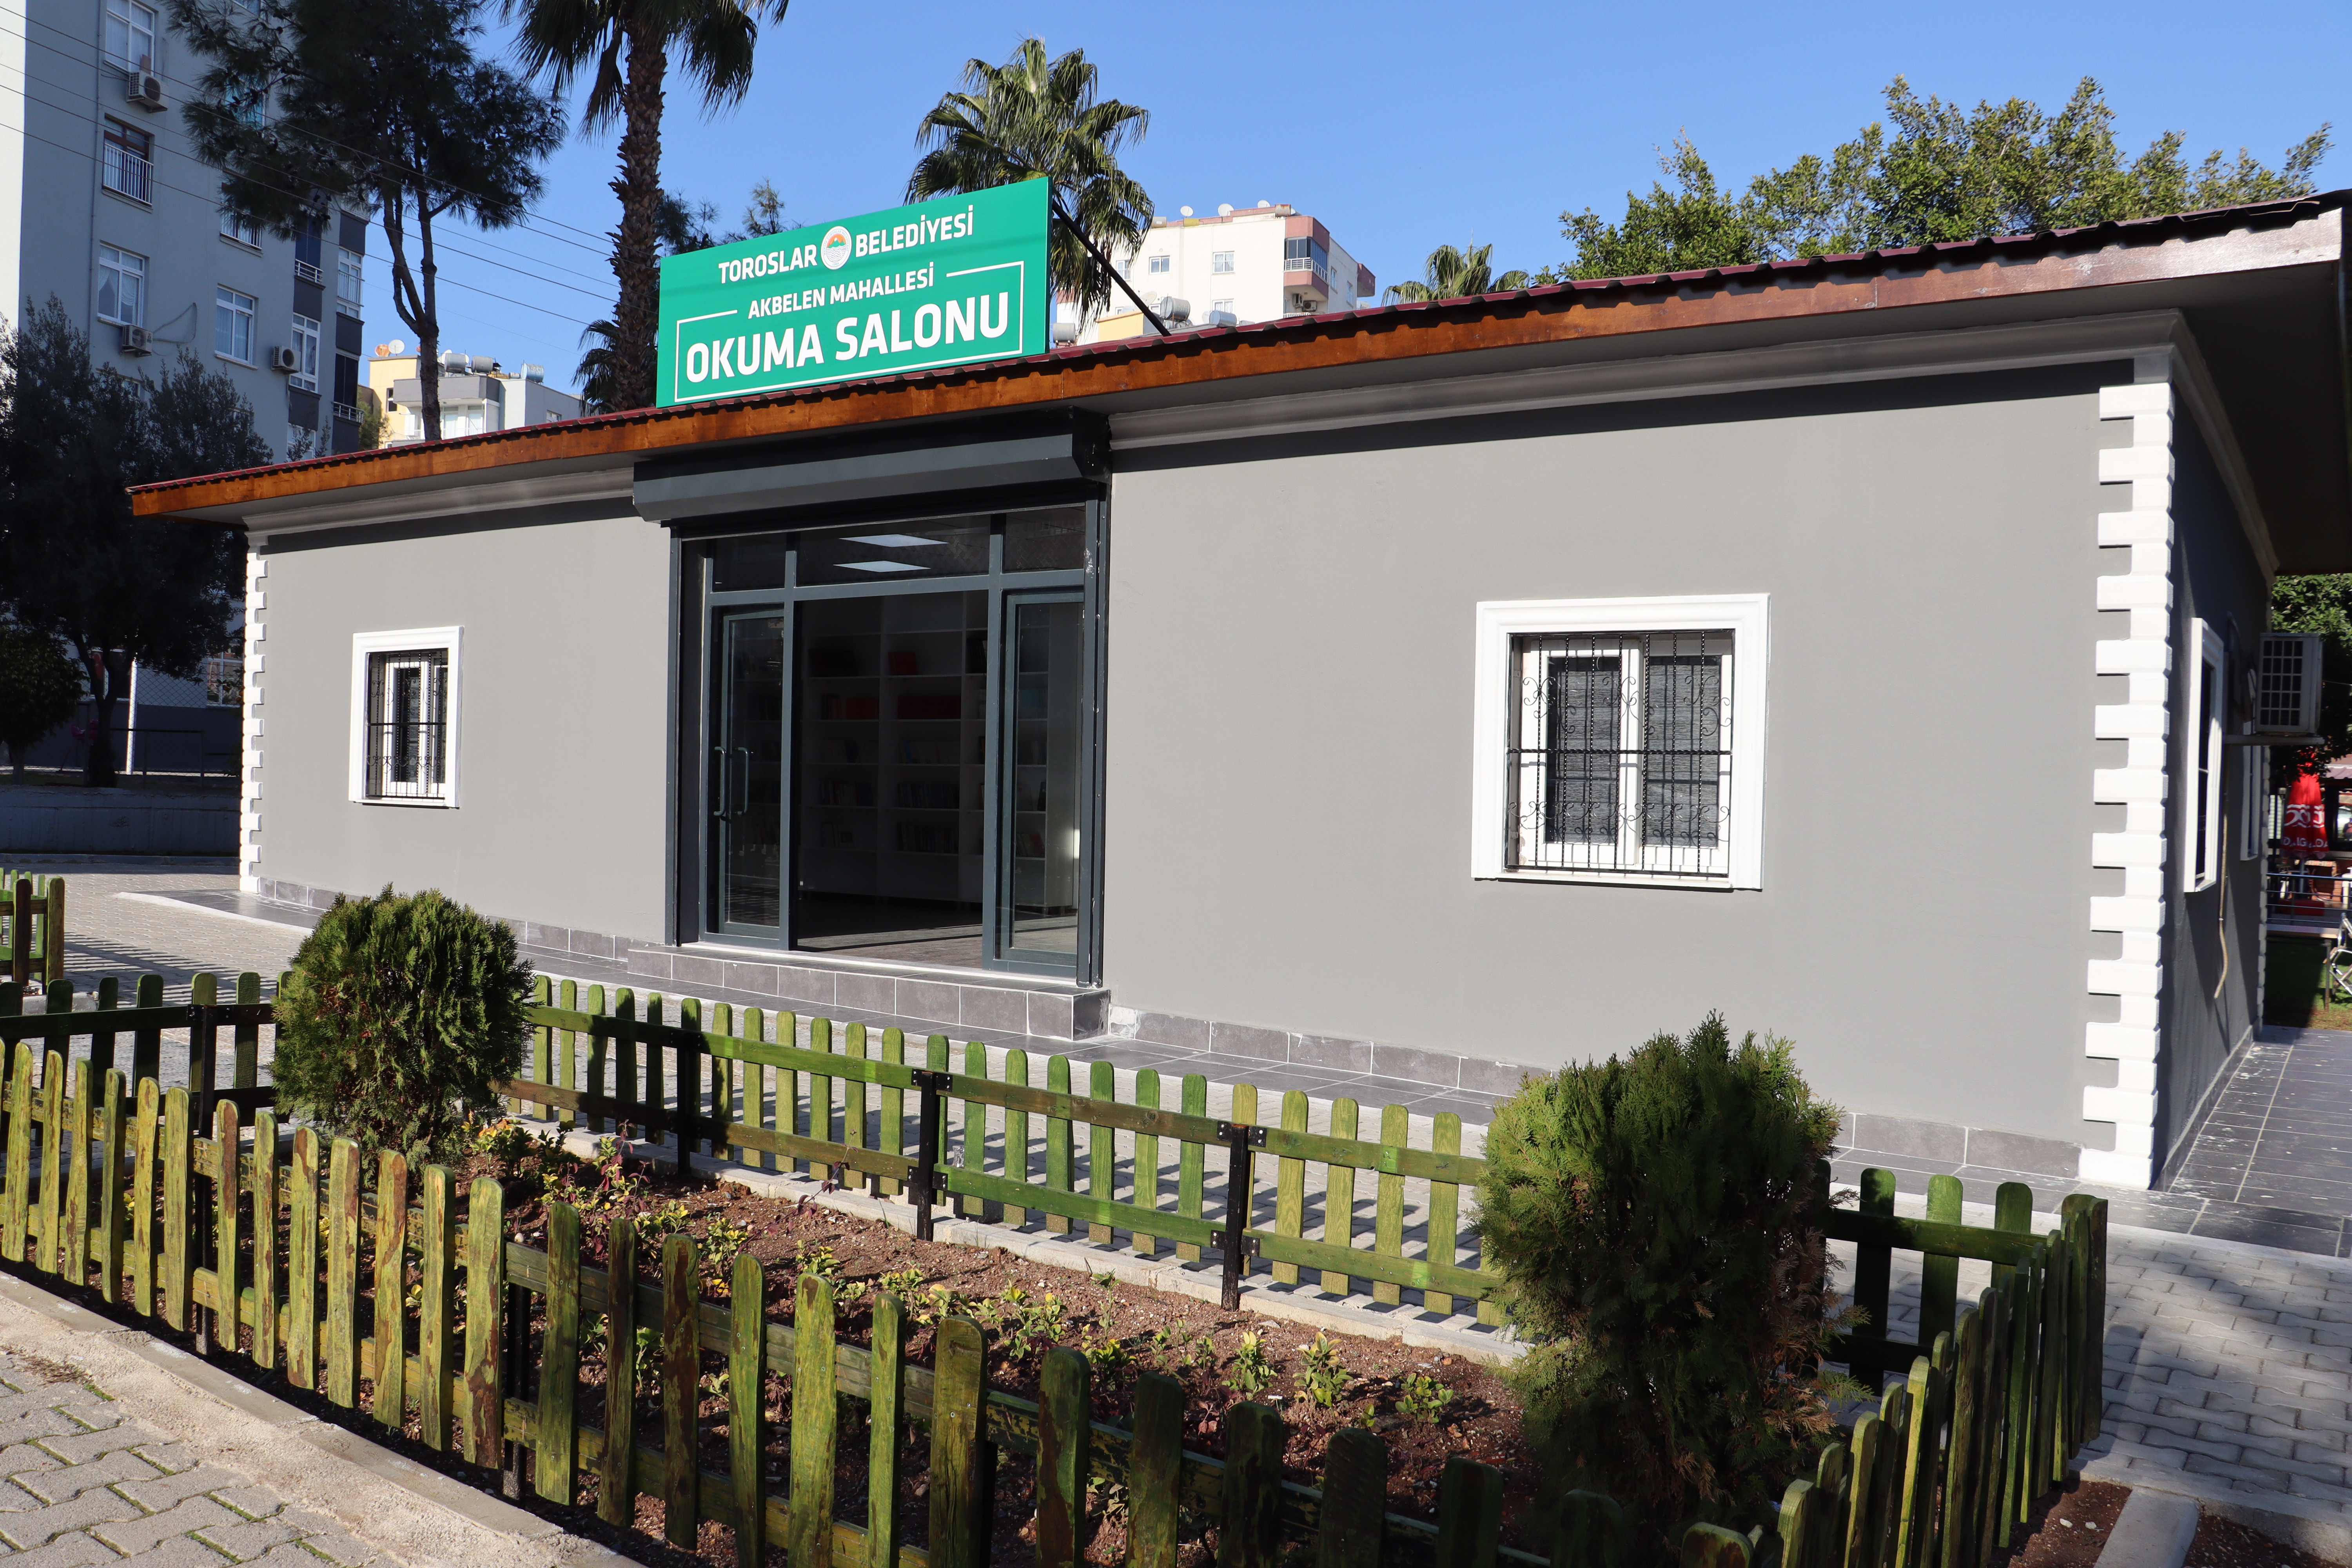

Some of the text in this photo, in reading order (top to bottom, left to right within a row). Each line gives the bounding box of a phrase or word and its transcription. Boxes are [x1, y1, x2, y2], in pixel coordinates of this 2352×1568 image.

[718, 204, 973, 284] TOROSLAR BELEDİYESİ
[748, 261, 934, 319] AKBELEN MAHALLESİ
[686, 292, 1008, 383] OKUMA SALONU
